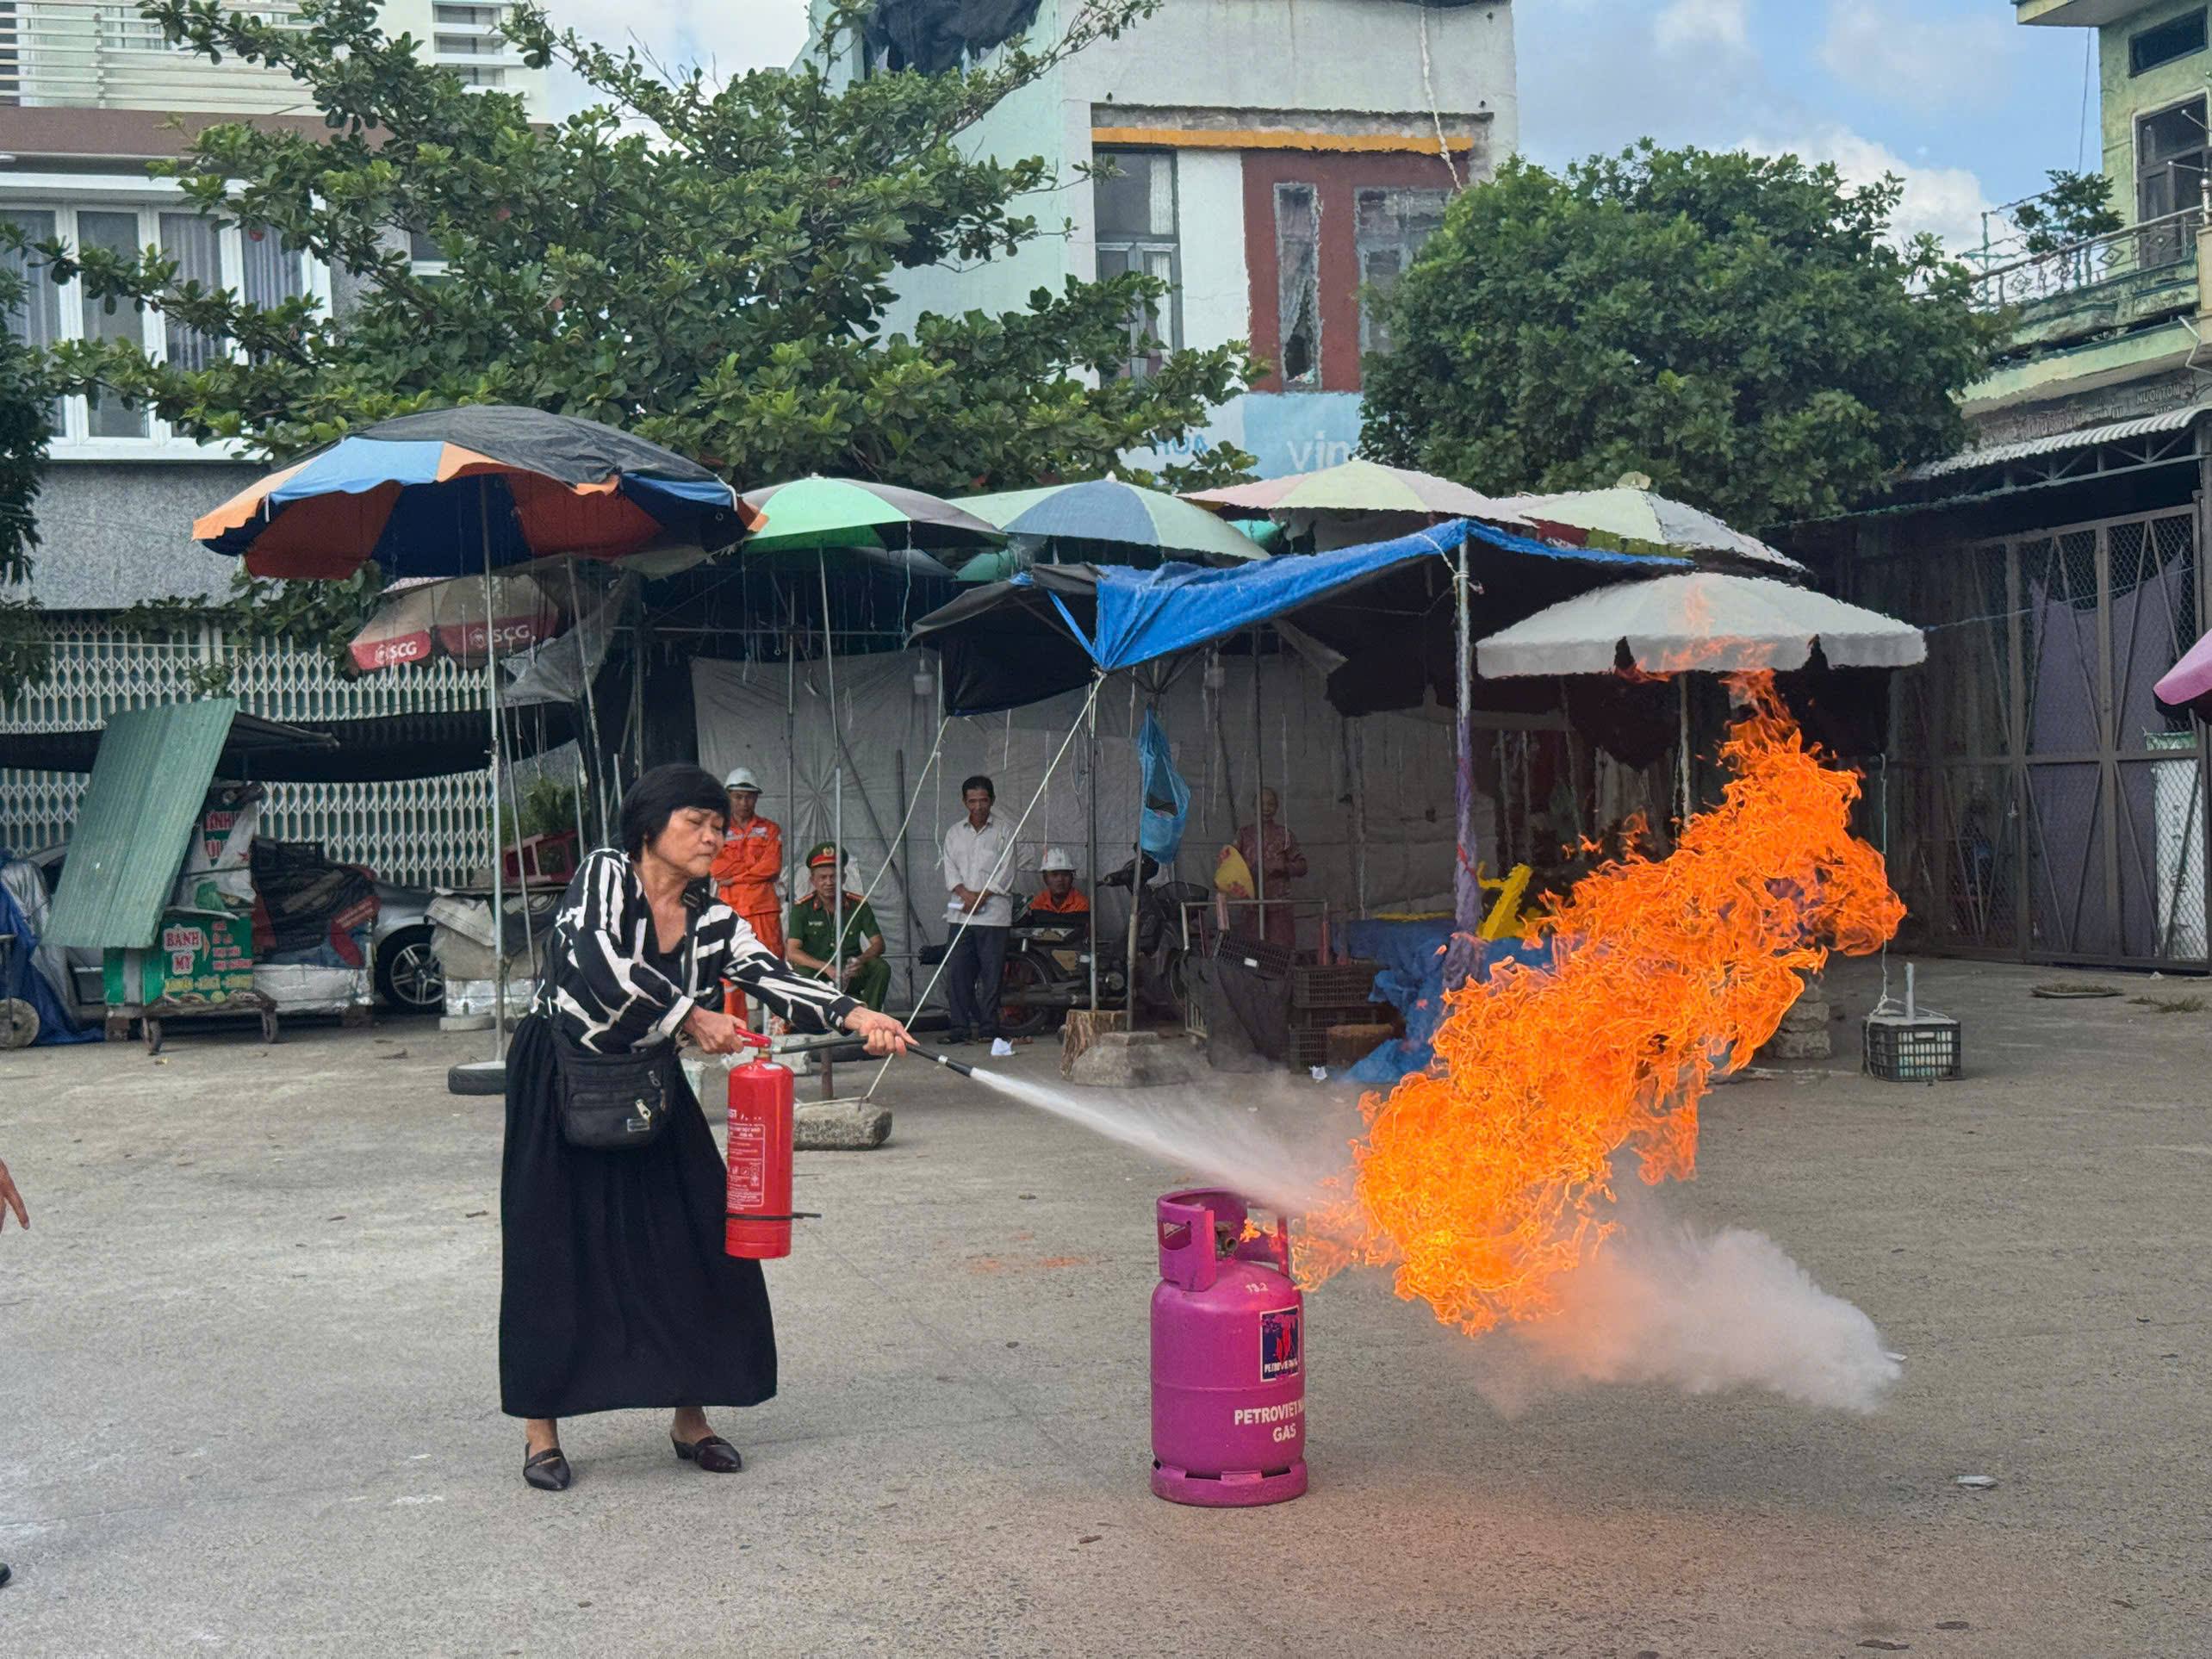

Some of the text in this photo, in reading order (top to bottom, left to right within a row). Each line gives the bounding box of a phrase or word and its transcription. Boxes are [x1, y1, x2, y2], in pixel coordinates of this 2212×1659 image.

[494, 624, 530, 643] SCG
[389, 641, 418, 659] SCG
[1272, 1423, 1297, 1444] GAS
